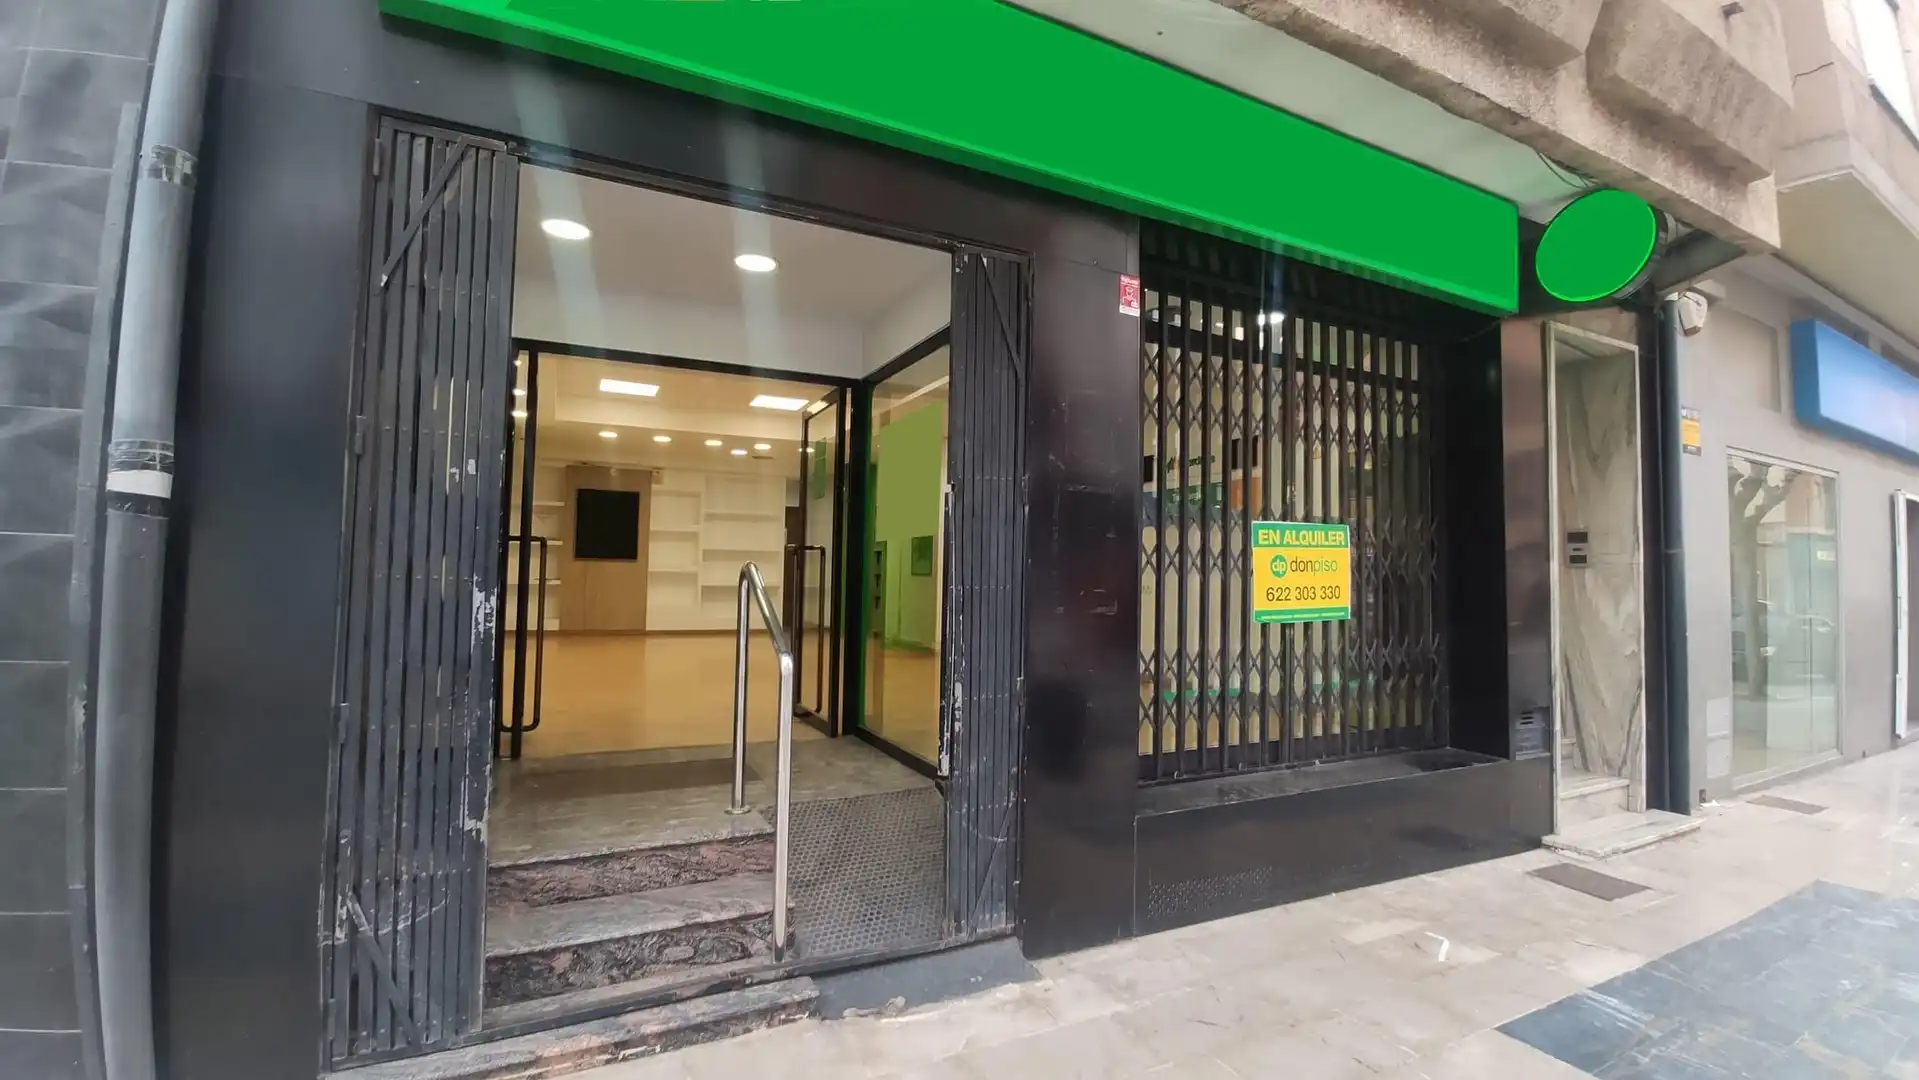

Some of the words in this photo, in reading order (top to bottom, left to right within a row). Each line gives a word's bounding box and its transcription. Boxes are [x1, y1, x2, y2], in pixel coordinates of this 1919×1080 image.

[1258, 529, 1280, 545] EN
[1284, 530, 1344, 545] ALQUILER
[1290, 556, 1338, 576] donpiso
[1266, 586, 1291, 602] 622
[1295, 586, 1316, 601] 303
[1320, 585, 1341, 600] 330
